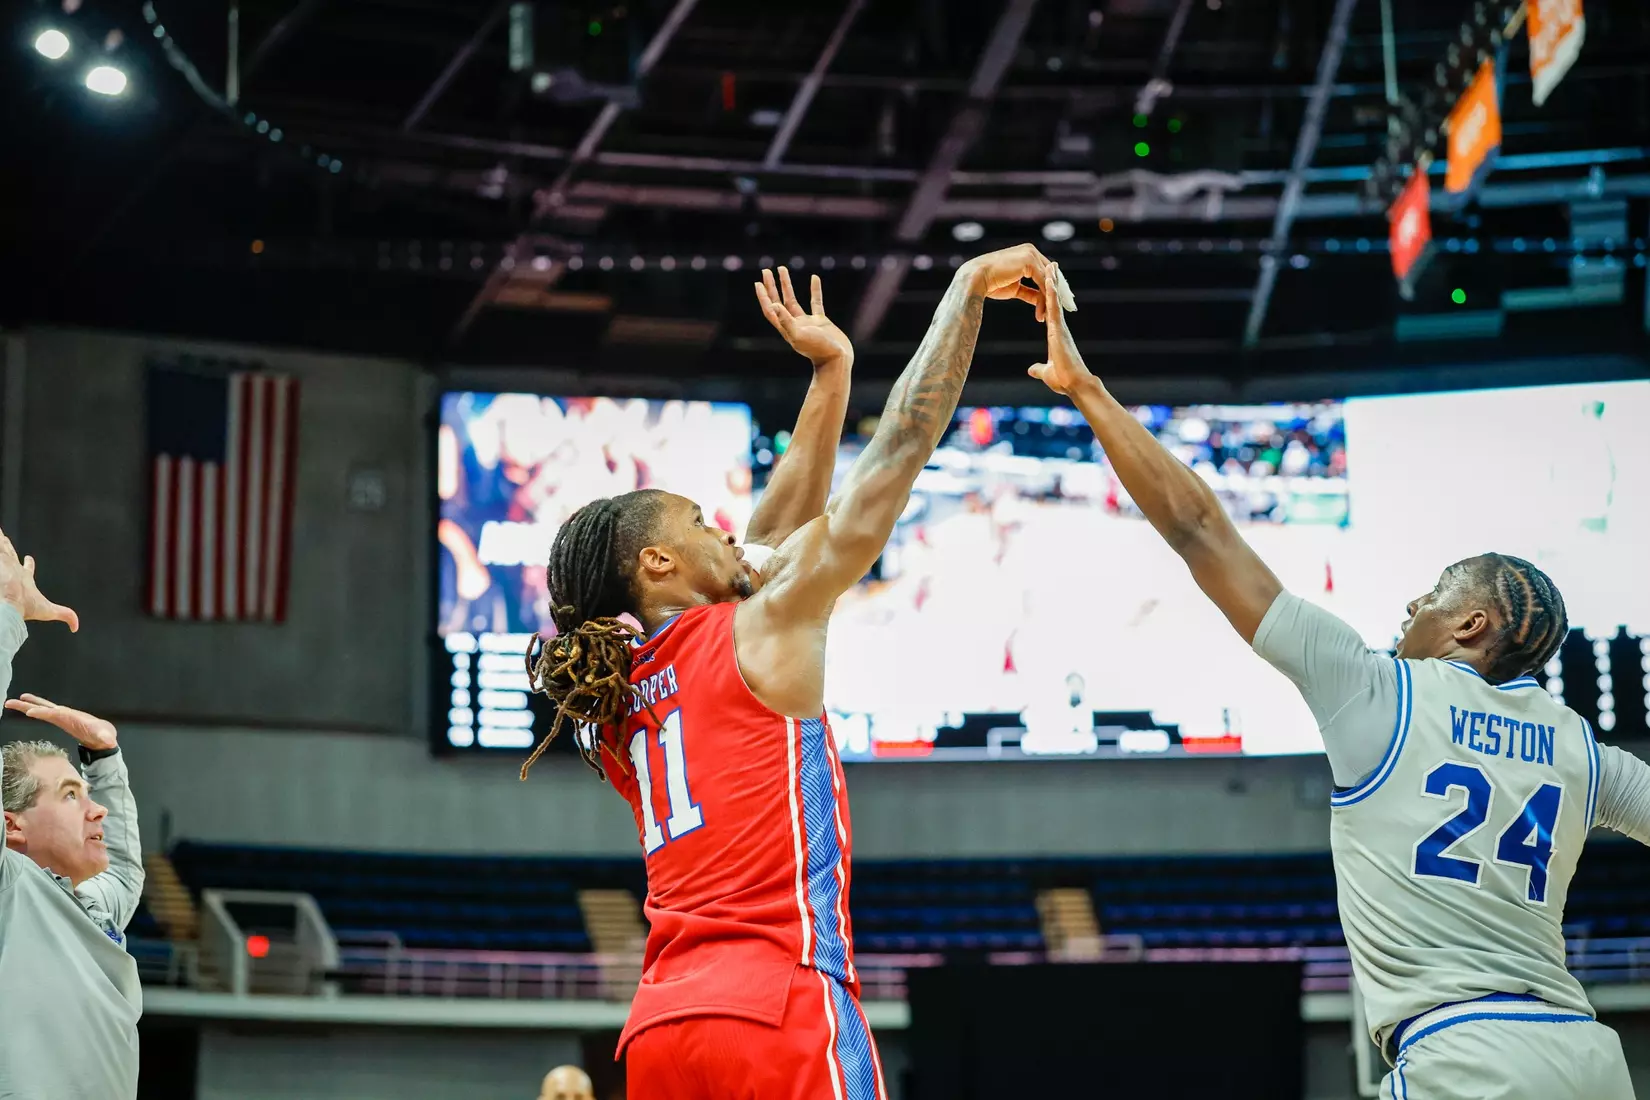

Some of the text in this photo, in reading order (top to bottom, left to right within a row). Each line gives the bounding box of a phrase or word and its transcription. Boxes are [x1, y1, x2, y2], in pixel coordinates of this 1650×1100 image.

[622, 664, 679, 717] OOPER
[1449, 704, 1556, 767] WESTON
[627, 706, 706, 856] 11
[1411, 759, 1565, 905] 24
